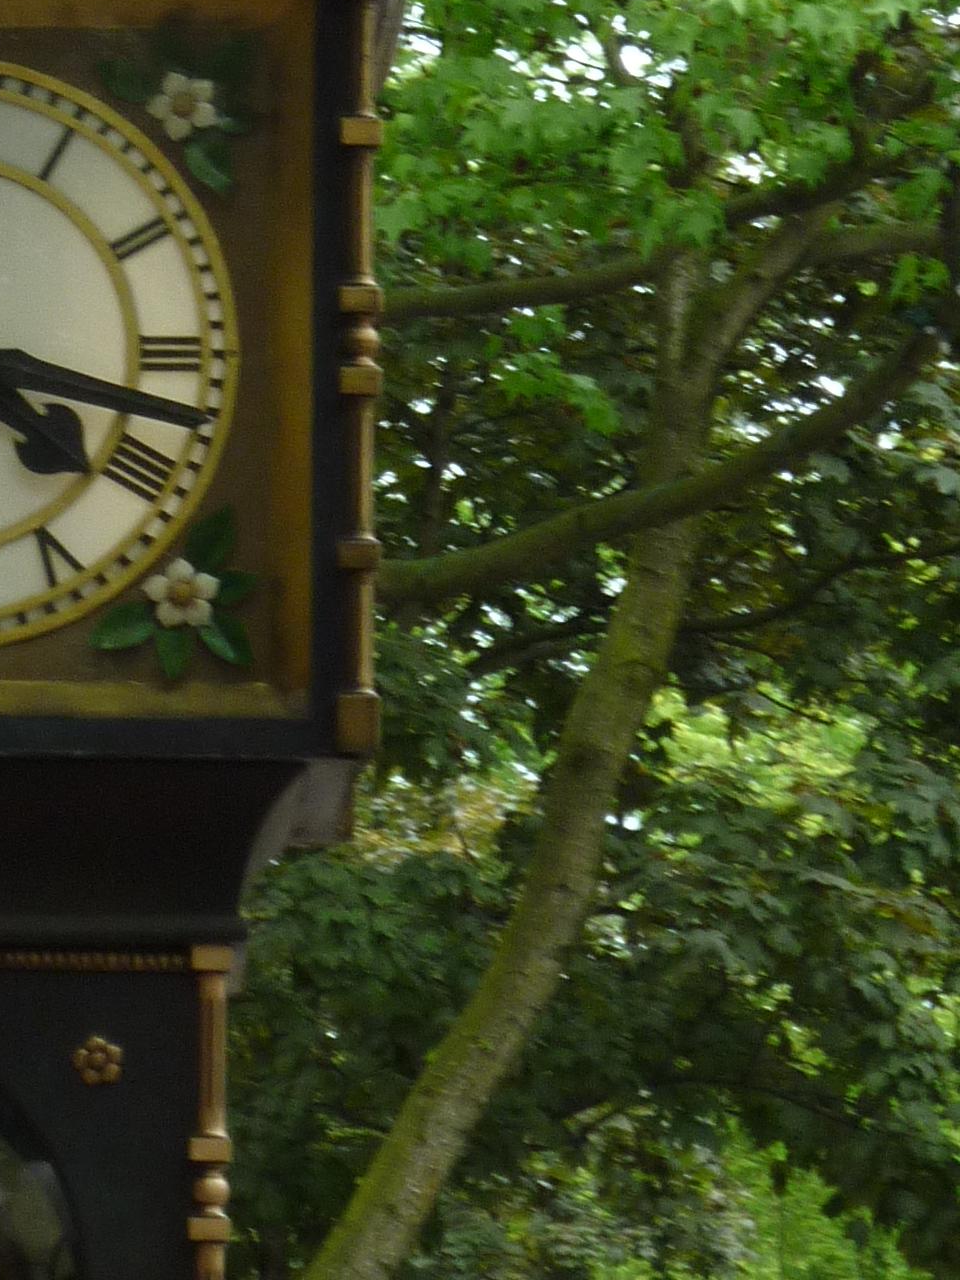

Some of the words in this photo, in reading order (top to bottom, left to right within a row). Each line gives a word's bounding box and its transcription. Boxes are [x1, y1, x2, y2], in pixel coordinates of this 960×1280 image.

[41, 122, 74, 179] I
[110, 217, 171, 260] II
[139, 335, 202, 373] III
[101, 432, 177, 504] IIII
[36, 526, 85, 588] V
